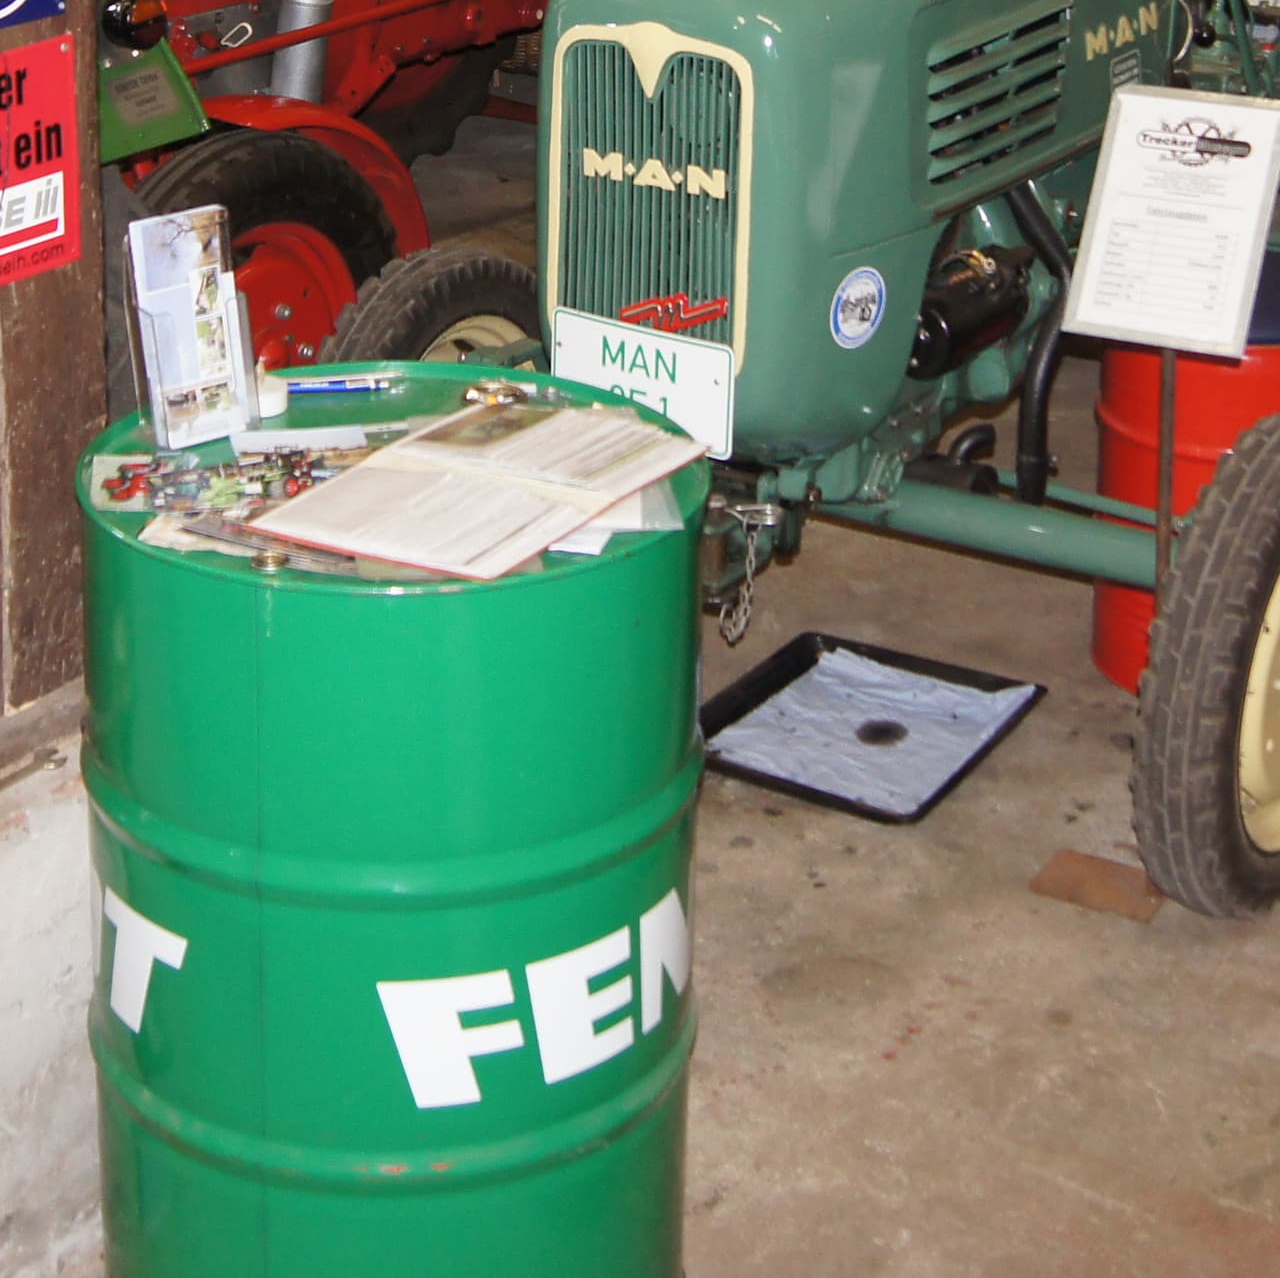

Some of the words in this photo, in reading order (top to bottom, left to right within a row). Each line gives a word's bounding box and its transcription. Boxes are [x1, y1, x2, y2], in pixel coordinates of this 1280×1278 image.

[13, 121, 63, 172] ein
[1141, 131, 1194, 149] Trecker
[601, 335, 677, 384] MAN
[376, 887, 689, 1109] FEN
